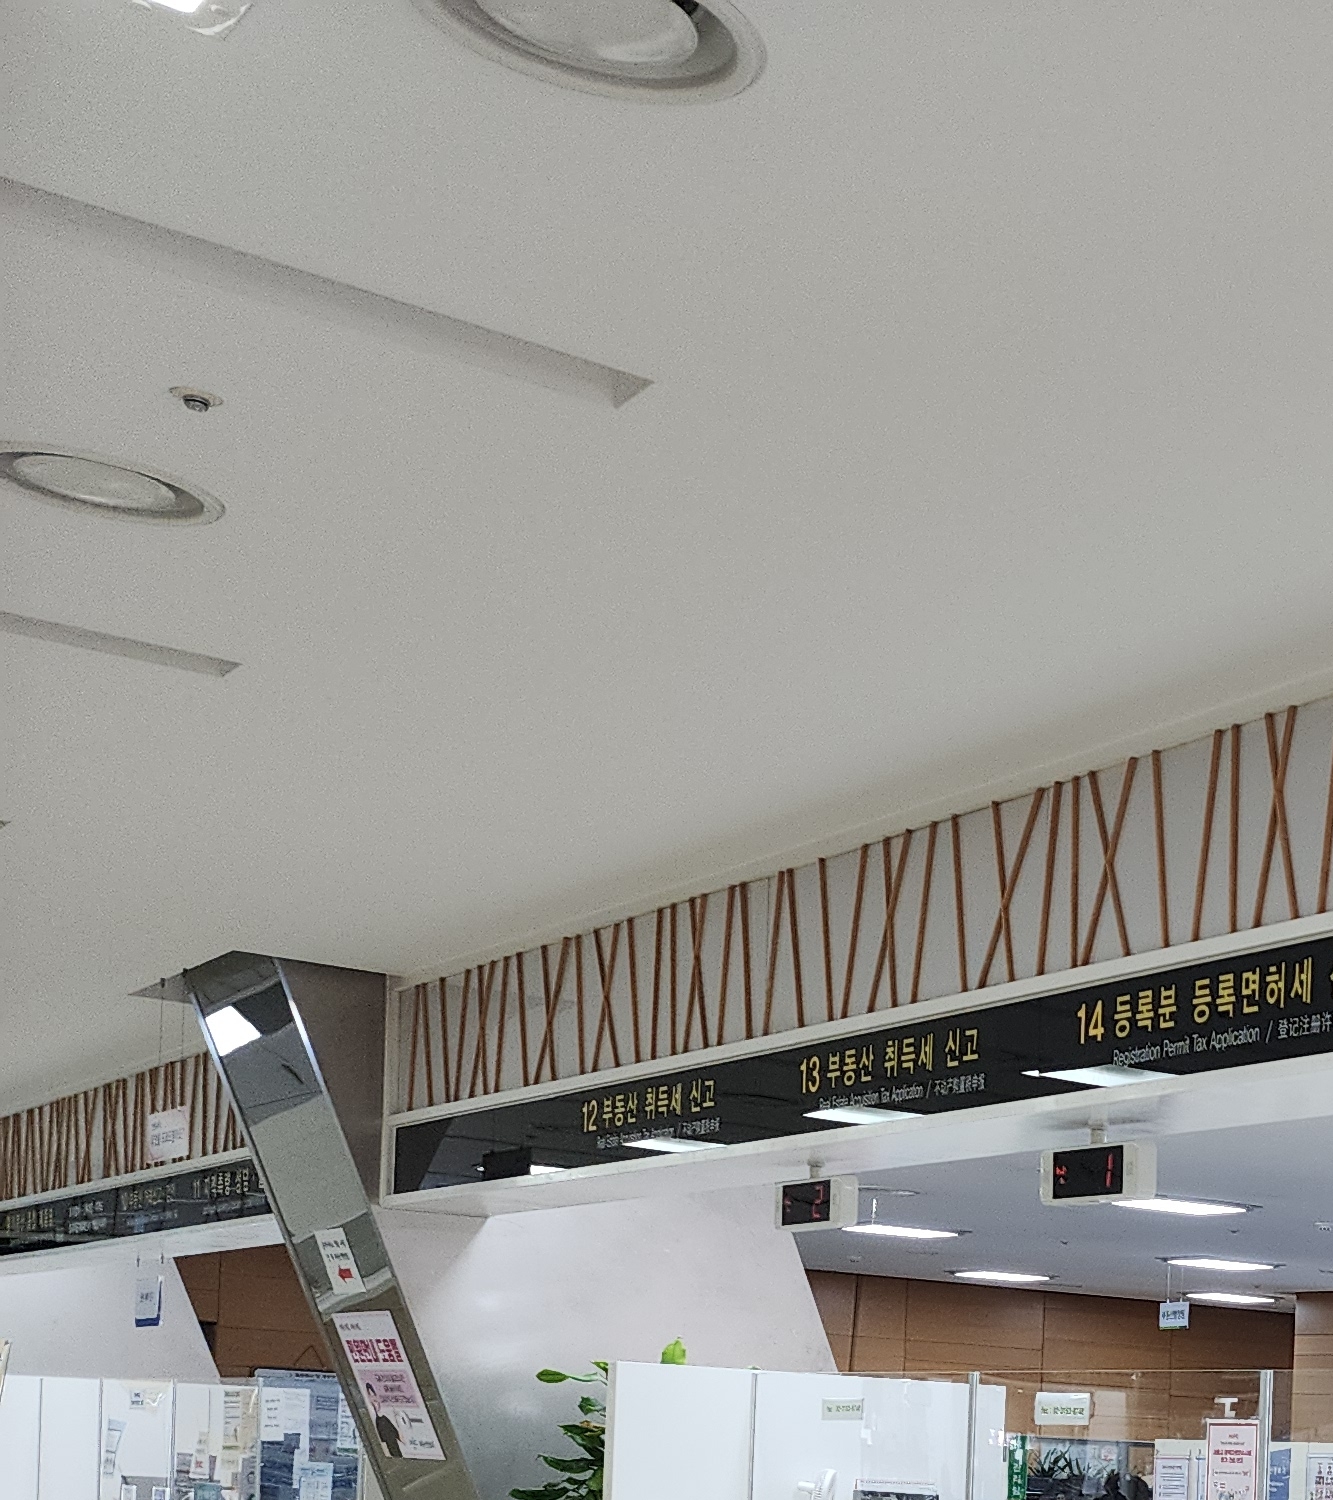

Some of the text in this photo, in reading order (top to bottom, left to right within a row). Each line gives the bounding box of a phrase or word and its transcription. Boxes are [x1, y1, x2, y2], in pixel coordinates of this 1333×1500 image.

[1077, 1001, 1105, 1045] 14
[1113, 984, 1177, 1039] 등록분
[1192, 957, 1313, 1023] 등록면허세
[800, 1027, 979, 1094] 13 부동산 취득세 신고
[1113, 1041, 1161, 1066] Registration
[1163, 1036, 1190, 1055] Permit
[1193, 1033, 1207, 1050] Tax
[1210, 1026, 1260, 1047] Application
[582, 1078, 715, 1133] 12 부동산 취득세 신고
